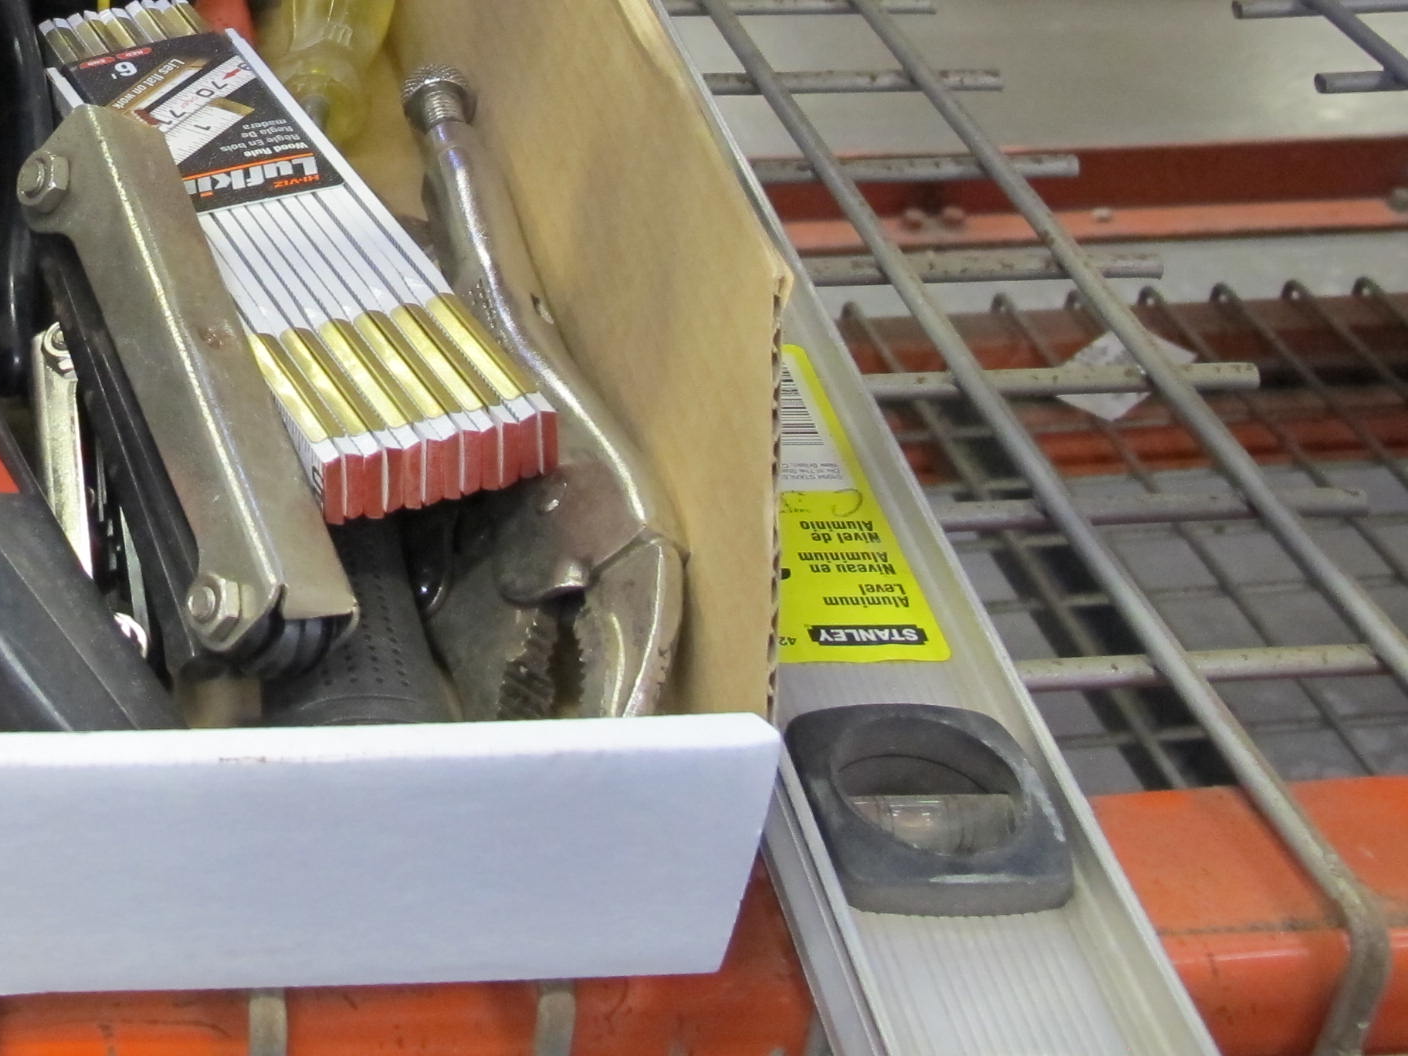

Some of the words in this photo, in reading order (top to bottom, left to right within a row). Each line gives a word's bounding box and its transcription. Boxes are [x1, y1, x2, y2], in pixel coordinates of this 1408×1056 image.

[158, 58, 185, 74] Lies
[132, 84, 147, 96] on
[242, 118, 287, 130] madera
[248, 138, 265, 147] En
[275, 141, 309, 150] Wood
[243, 147, 273, 157] Rule
[800, 520, 874, 532] Aluminio
[811, 531, 832, 543] de
[840, 531, 881, 544] Nivel
[797, 551, 889, 563] Aluminium
[809, 564, 831, 574] en
[836, 562, 896, 576] Niveau
[859, 582, 906, 595] Level
[823, 595, 910, 608] Aluminum
[818, 627, 919, 643] STANLEY
